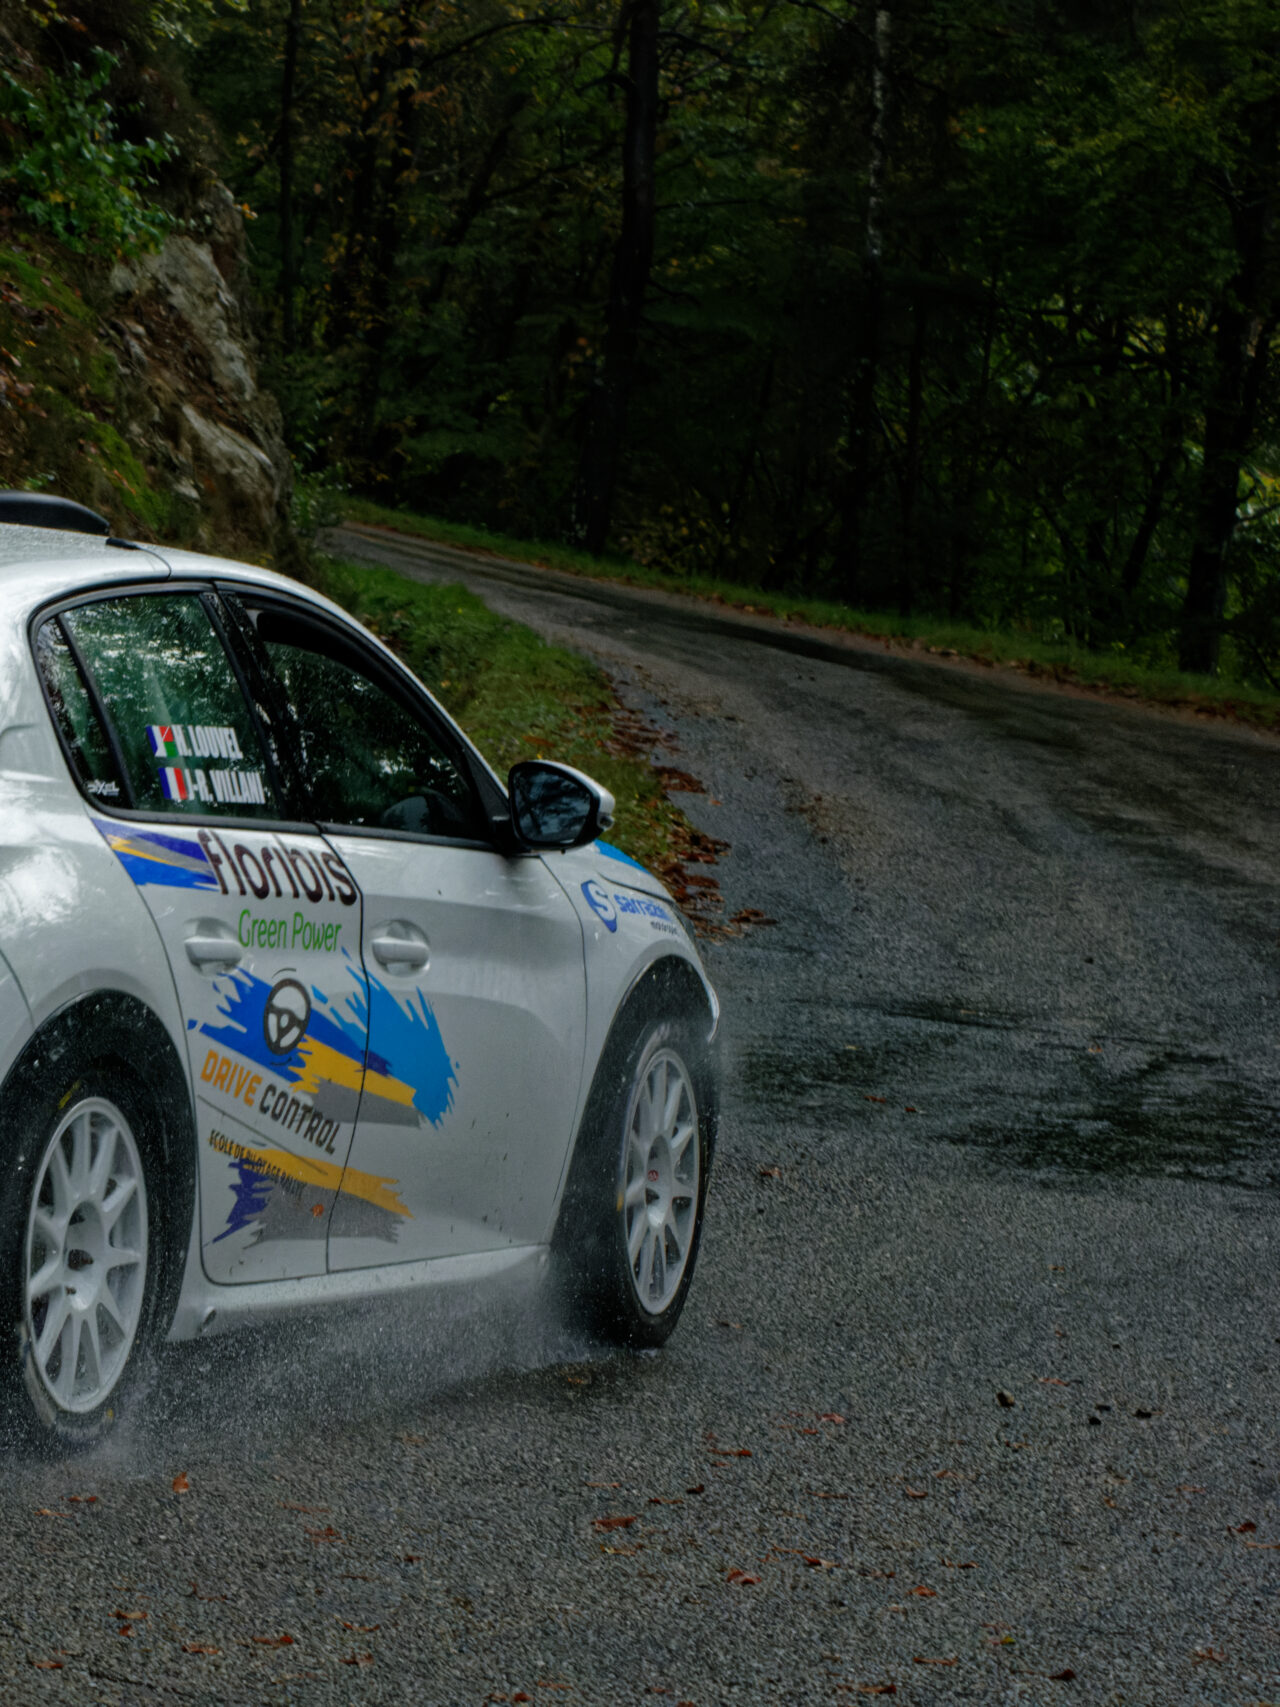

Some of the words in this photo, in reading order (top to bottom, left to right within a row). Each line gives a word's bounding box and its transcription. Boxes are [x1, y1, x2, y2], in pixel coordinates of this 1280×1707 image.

[187, 725, 244, 760] LOUVEL
[209, 769, 266, 805] VILLANI
[238, 908, 287, 949] Green
[292, 911, 342, 952] Power
[200, 1049, 263, 1108] DRIVE
[258, 1083, 341, 1156] CONTROL
